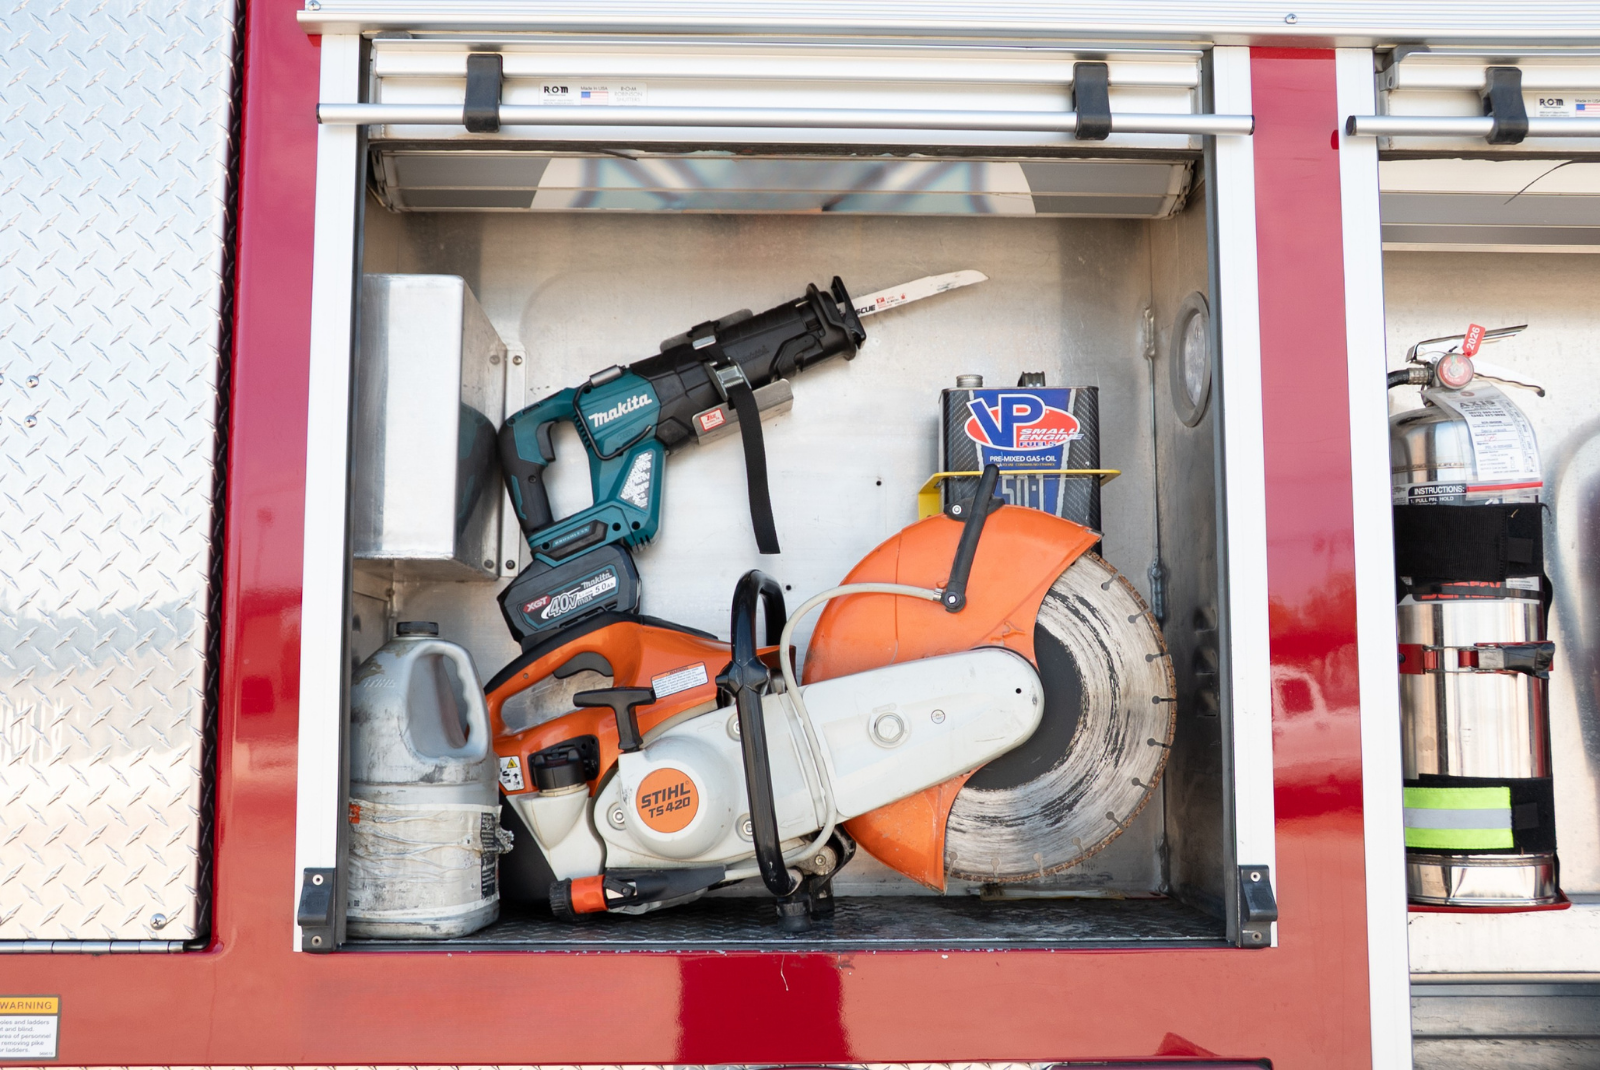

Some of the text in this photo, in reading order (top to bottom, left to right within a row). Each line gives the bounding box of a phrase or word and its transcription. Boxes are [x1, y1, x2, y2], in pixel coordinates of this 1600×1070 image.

[856, 304, 876, 315] SCUE
[1466, 327, 1480, 350] 2026
[589, 393, 652, 428] Makita
[966, 394, 1045, 448] VP
[1414, 486, 1465, 495] INSTRUCTIONS:
[580, 572, 612, 589] Makita
[527, 596, 548, 612] XGT
[578, 595, 593, 606] max
[641, 783, 690, 809] STIHL
[649, 797, 690, 818] TS 420
[0, 1001, 52, 1010] WARNING
